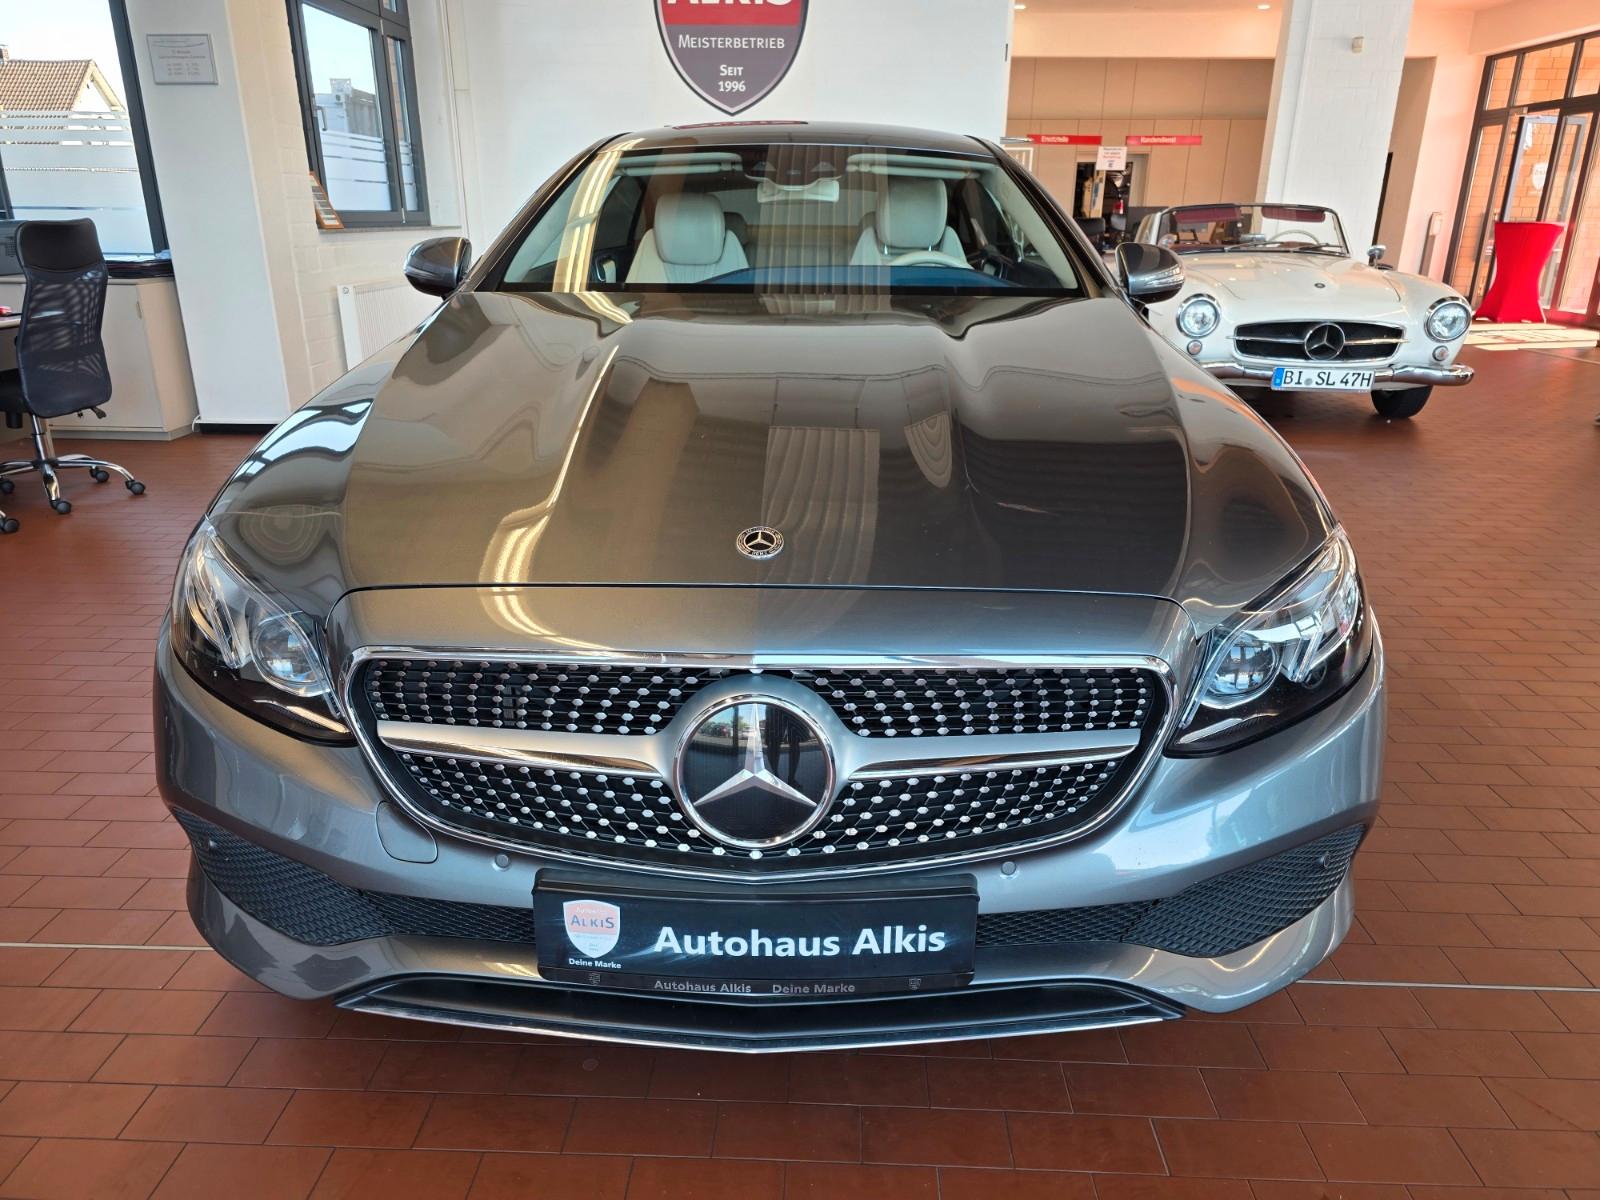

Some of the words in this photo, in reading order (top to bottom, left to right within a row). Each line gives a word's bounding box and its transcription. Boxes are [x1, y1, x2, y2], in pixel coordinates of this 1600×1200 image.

[718, 80, 746, 92] 1996
[1283, 370, 1303, 385] BI
[1315, 371, 1336, 386] SL
[1340, 372, 1373, 387] 47H
[654, 926, 841, 957] Autohaus
[852, 924, 946, 955] Alkis
[568, 958, 593, 967] Deine
[594, 960, 622, 969] Marke
[654, 980, 717, 993] Autohaus
[719, 982, 752, 993] Alkis
[772, 983, 810, 994] Deine
[813, 983, 856, 994] Marke
